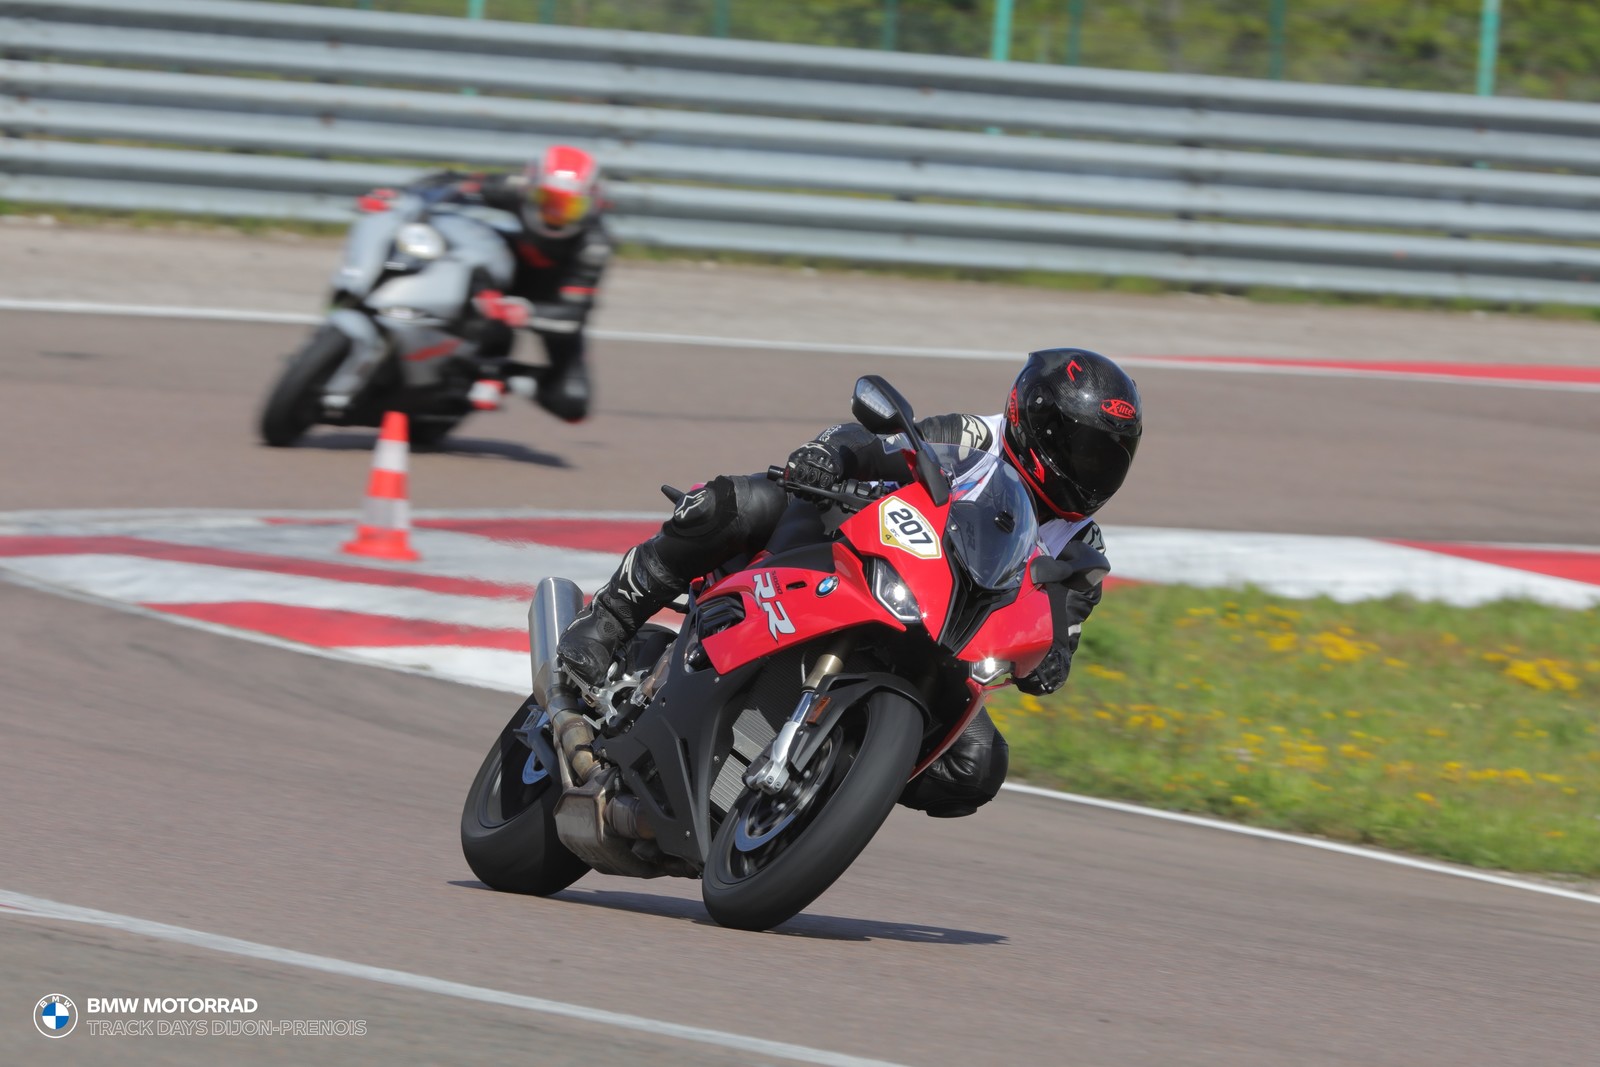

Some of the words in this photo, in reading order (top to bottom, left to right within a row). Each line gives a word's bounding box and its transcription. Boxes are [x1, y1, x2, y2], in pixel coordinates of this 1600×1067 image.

[1105, 399, 1134, 417] X-lite
[887, 508, 934, 544] 207
[752, 572, 796, 646] RR
